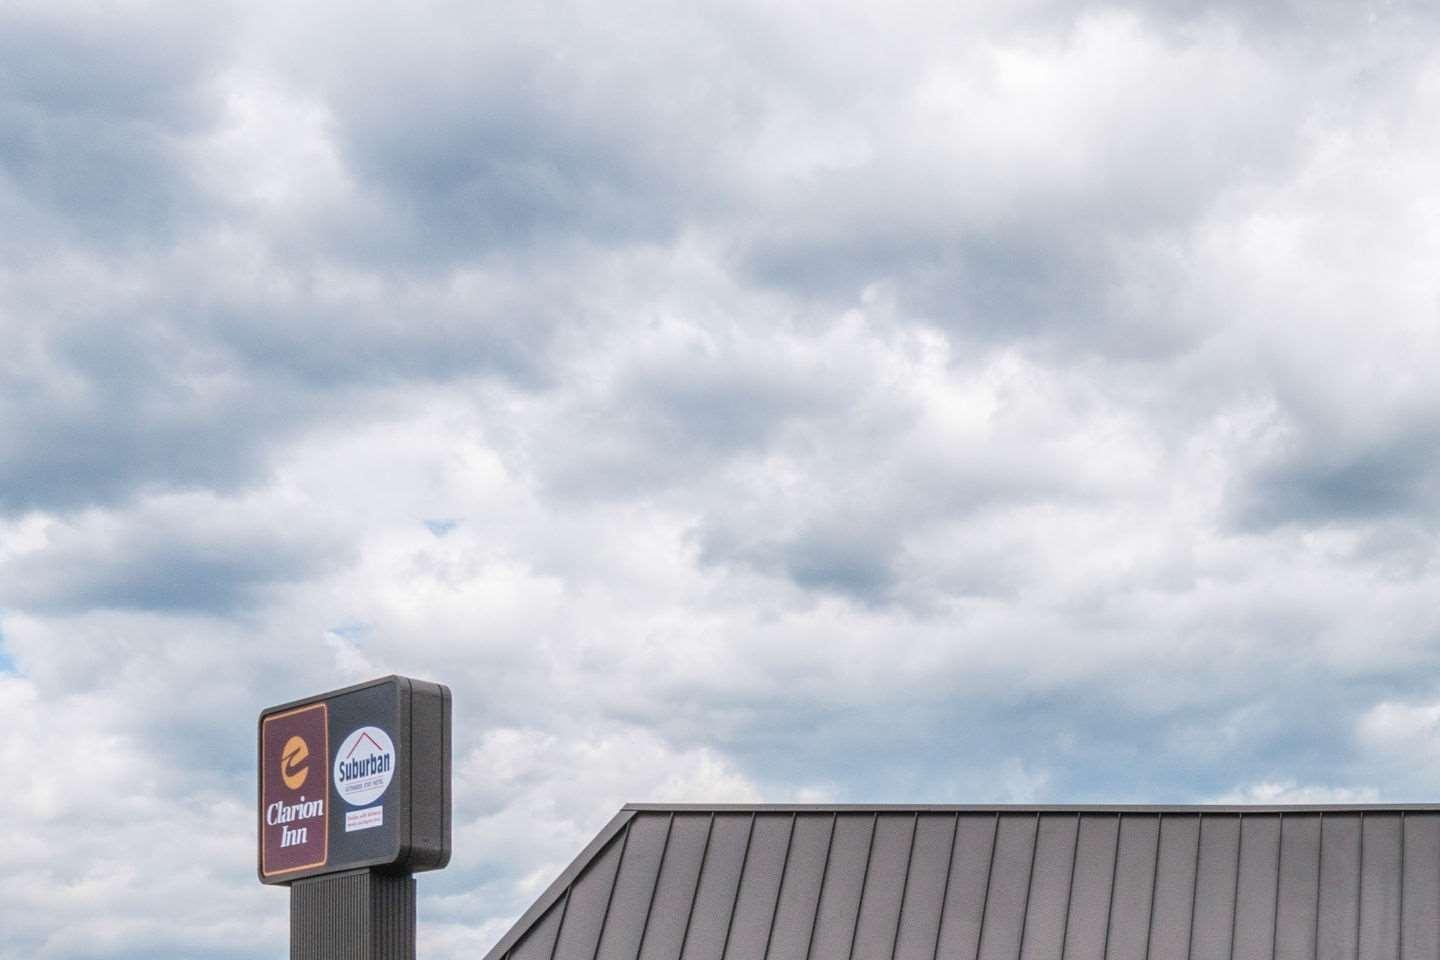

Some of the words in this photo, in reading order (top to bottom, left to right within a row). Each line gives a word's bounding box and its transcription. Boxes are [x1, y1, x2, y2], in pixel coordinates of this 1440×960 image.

[339, 752, 390, 782] Suburban
[267, 796, 323, 826] Clarion
[280, 826, 308, 848] Inn
